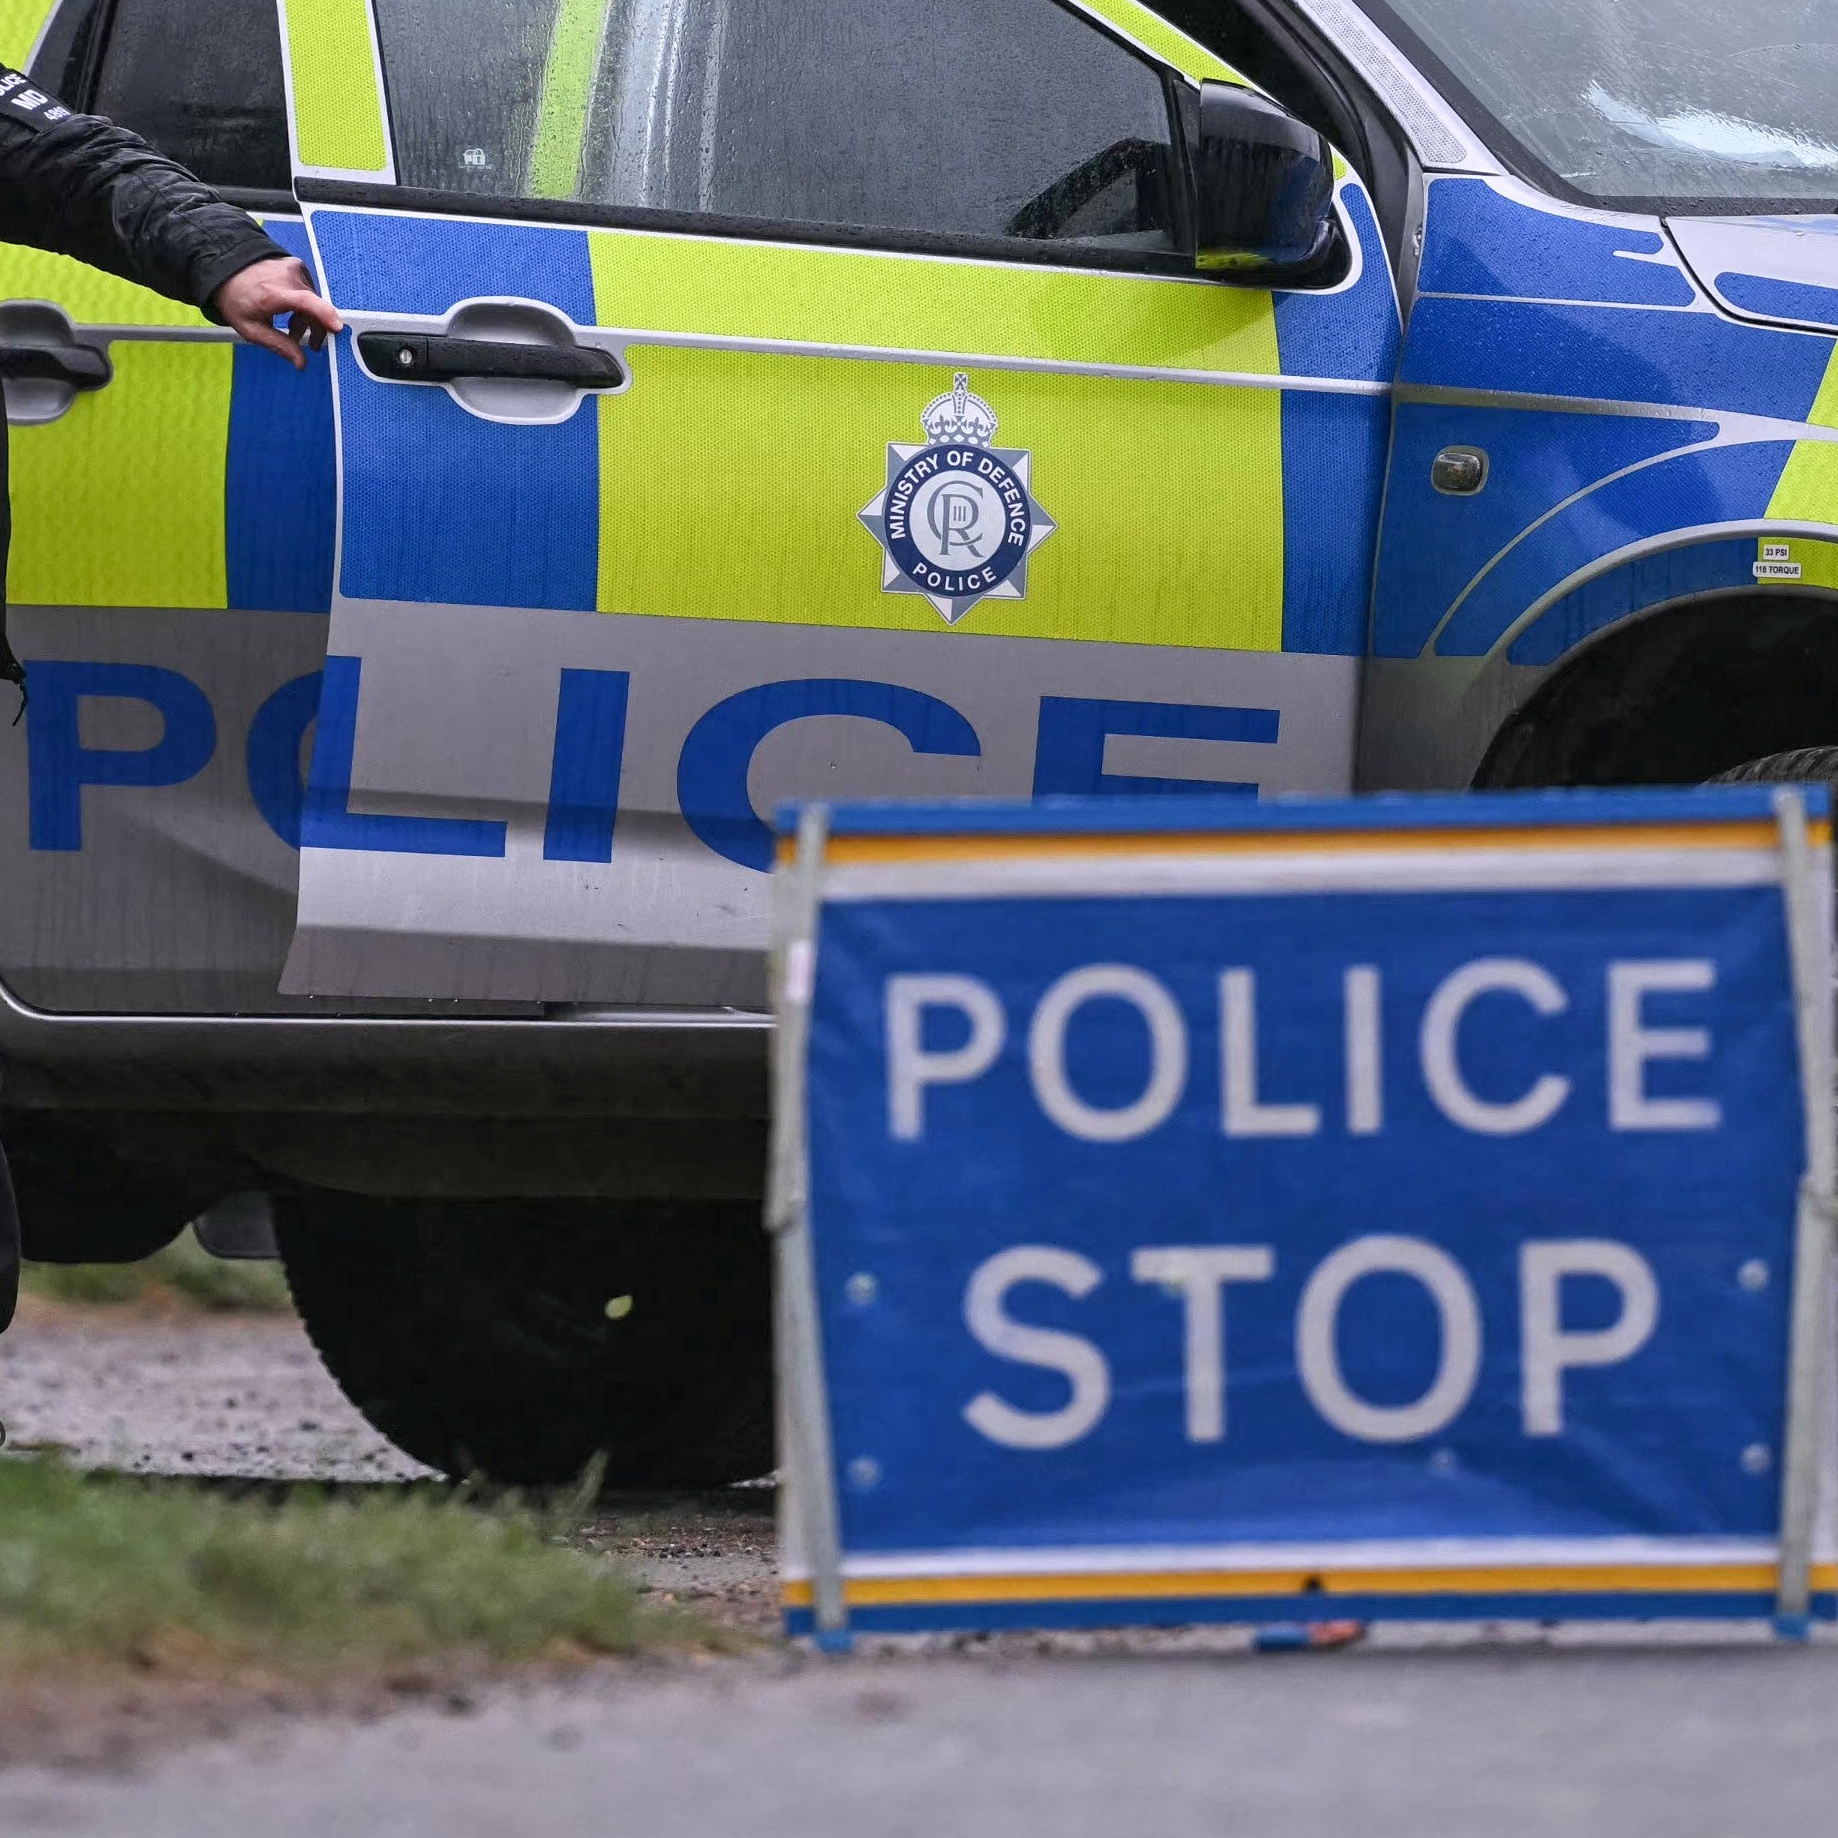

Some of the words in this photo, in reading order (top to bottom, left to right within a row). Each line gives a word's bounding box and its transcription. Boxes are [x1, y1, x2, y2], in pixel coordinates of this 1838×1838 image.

[10, 89, 48, 111] MD
[889, 453, 940, 540] MINISTRY
[946, 450, 974, 467] OF
[977, 457, 1027, 547] DEFENCE
[1775, 548, 1787, 556] PSI
[912, 562, 997, 592] POLICE
[1769, 566, 1799, 574] TORQUE
[882, 955, 1722, 1145] POLICE
[959, 1232, 1662, 1452] STOP
